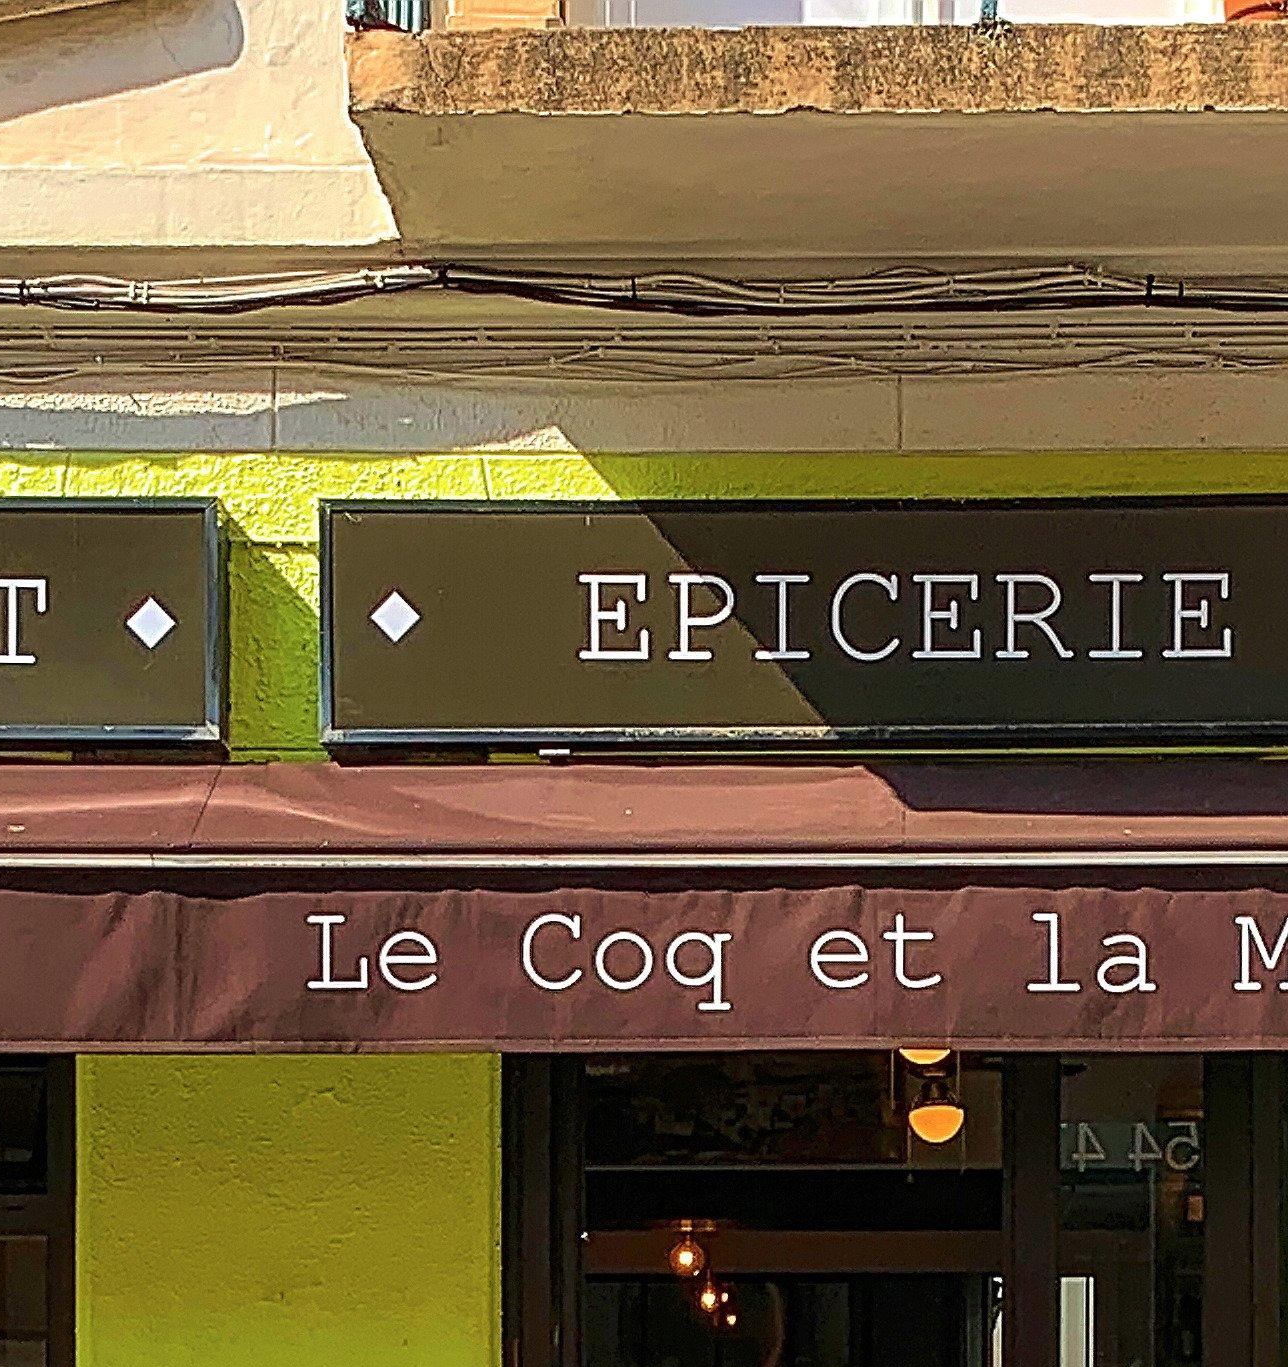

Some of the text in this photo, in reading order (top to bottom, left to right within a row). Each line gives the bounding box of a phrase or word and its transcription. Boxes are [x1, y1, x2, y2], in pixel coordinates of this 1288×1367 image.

[578, 571, 1235, 664] EPICERIE
[306, 912, 439, 992] Le
[520, 912, 733, 1012] Coq
[809, 912, 943, 991] et
[1026, 911, 1158, 993] la
